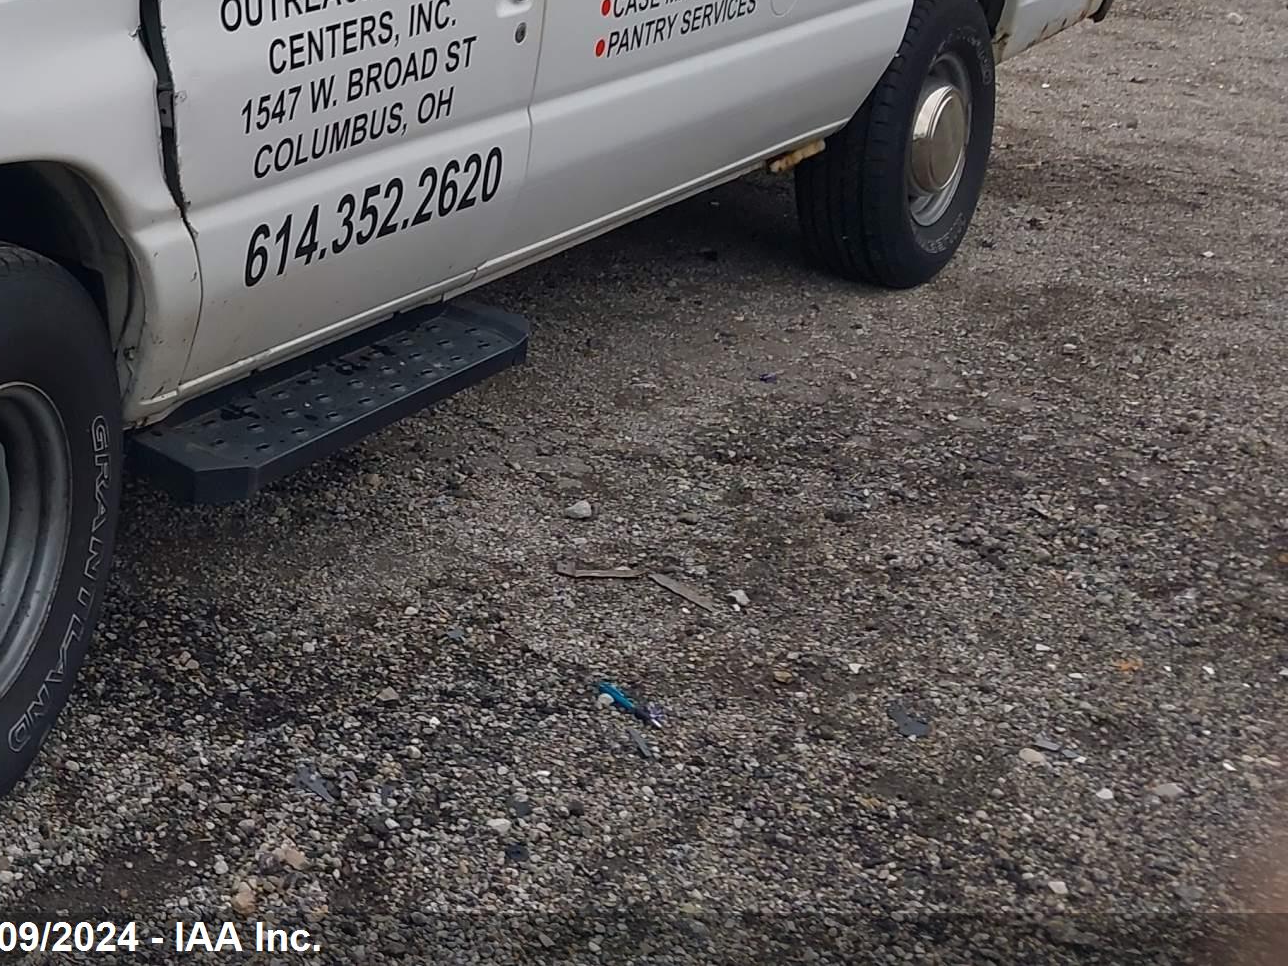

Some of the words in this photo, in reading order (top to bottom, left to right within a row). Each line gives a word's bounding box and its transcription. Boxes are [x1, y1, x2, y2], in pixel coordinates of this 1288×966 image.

[269, 10, 399, 75] CENTERS,
[607, 13, 678, 58] PANTRY
[242, 85, 302, 134] 1547
[311, 74, 337, 113] W.
[347, 47, 437, 102] BROAD
[446, 36, 477, 72] ST
[254, 101, 407, 179] COLUMBUS,
[417, 86, 454, 124] OH
[245, 147, 502, 287] 614.352.2620
